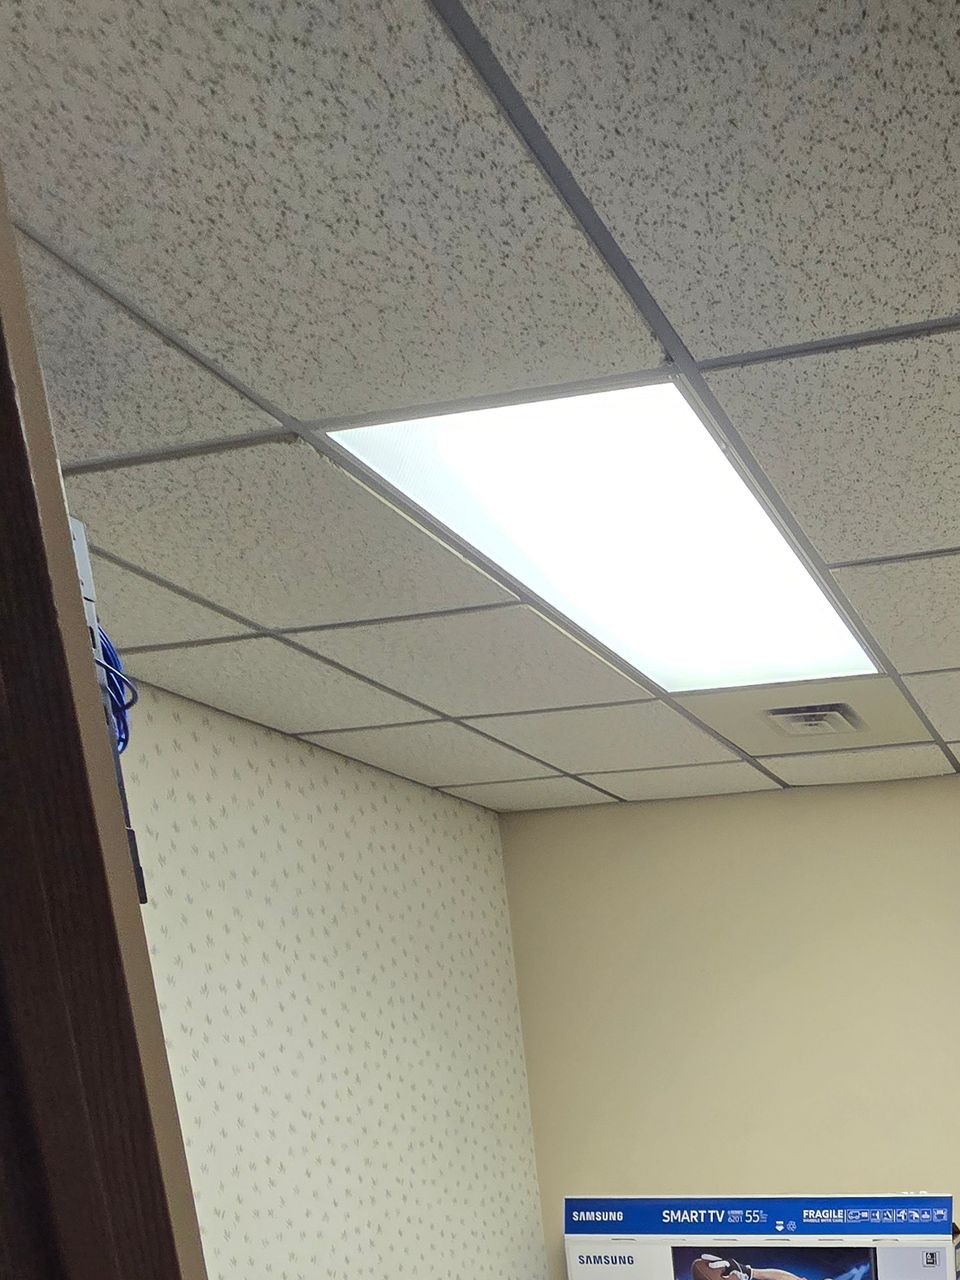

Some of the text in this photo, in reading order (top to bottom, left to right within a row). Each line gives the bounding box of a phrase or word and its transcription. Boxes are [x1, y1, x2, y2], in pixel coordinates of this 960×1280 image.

[572, 1211, 624, 1222] SAMSUNG
[662, 1209, 725, 1223] SMART TV
[802, 1209, 844, 1219] FRAGILE
[578, 1255, 635, 1265] SAMSUNG
